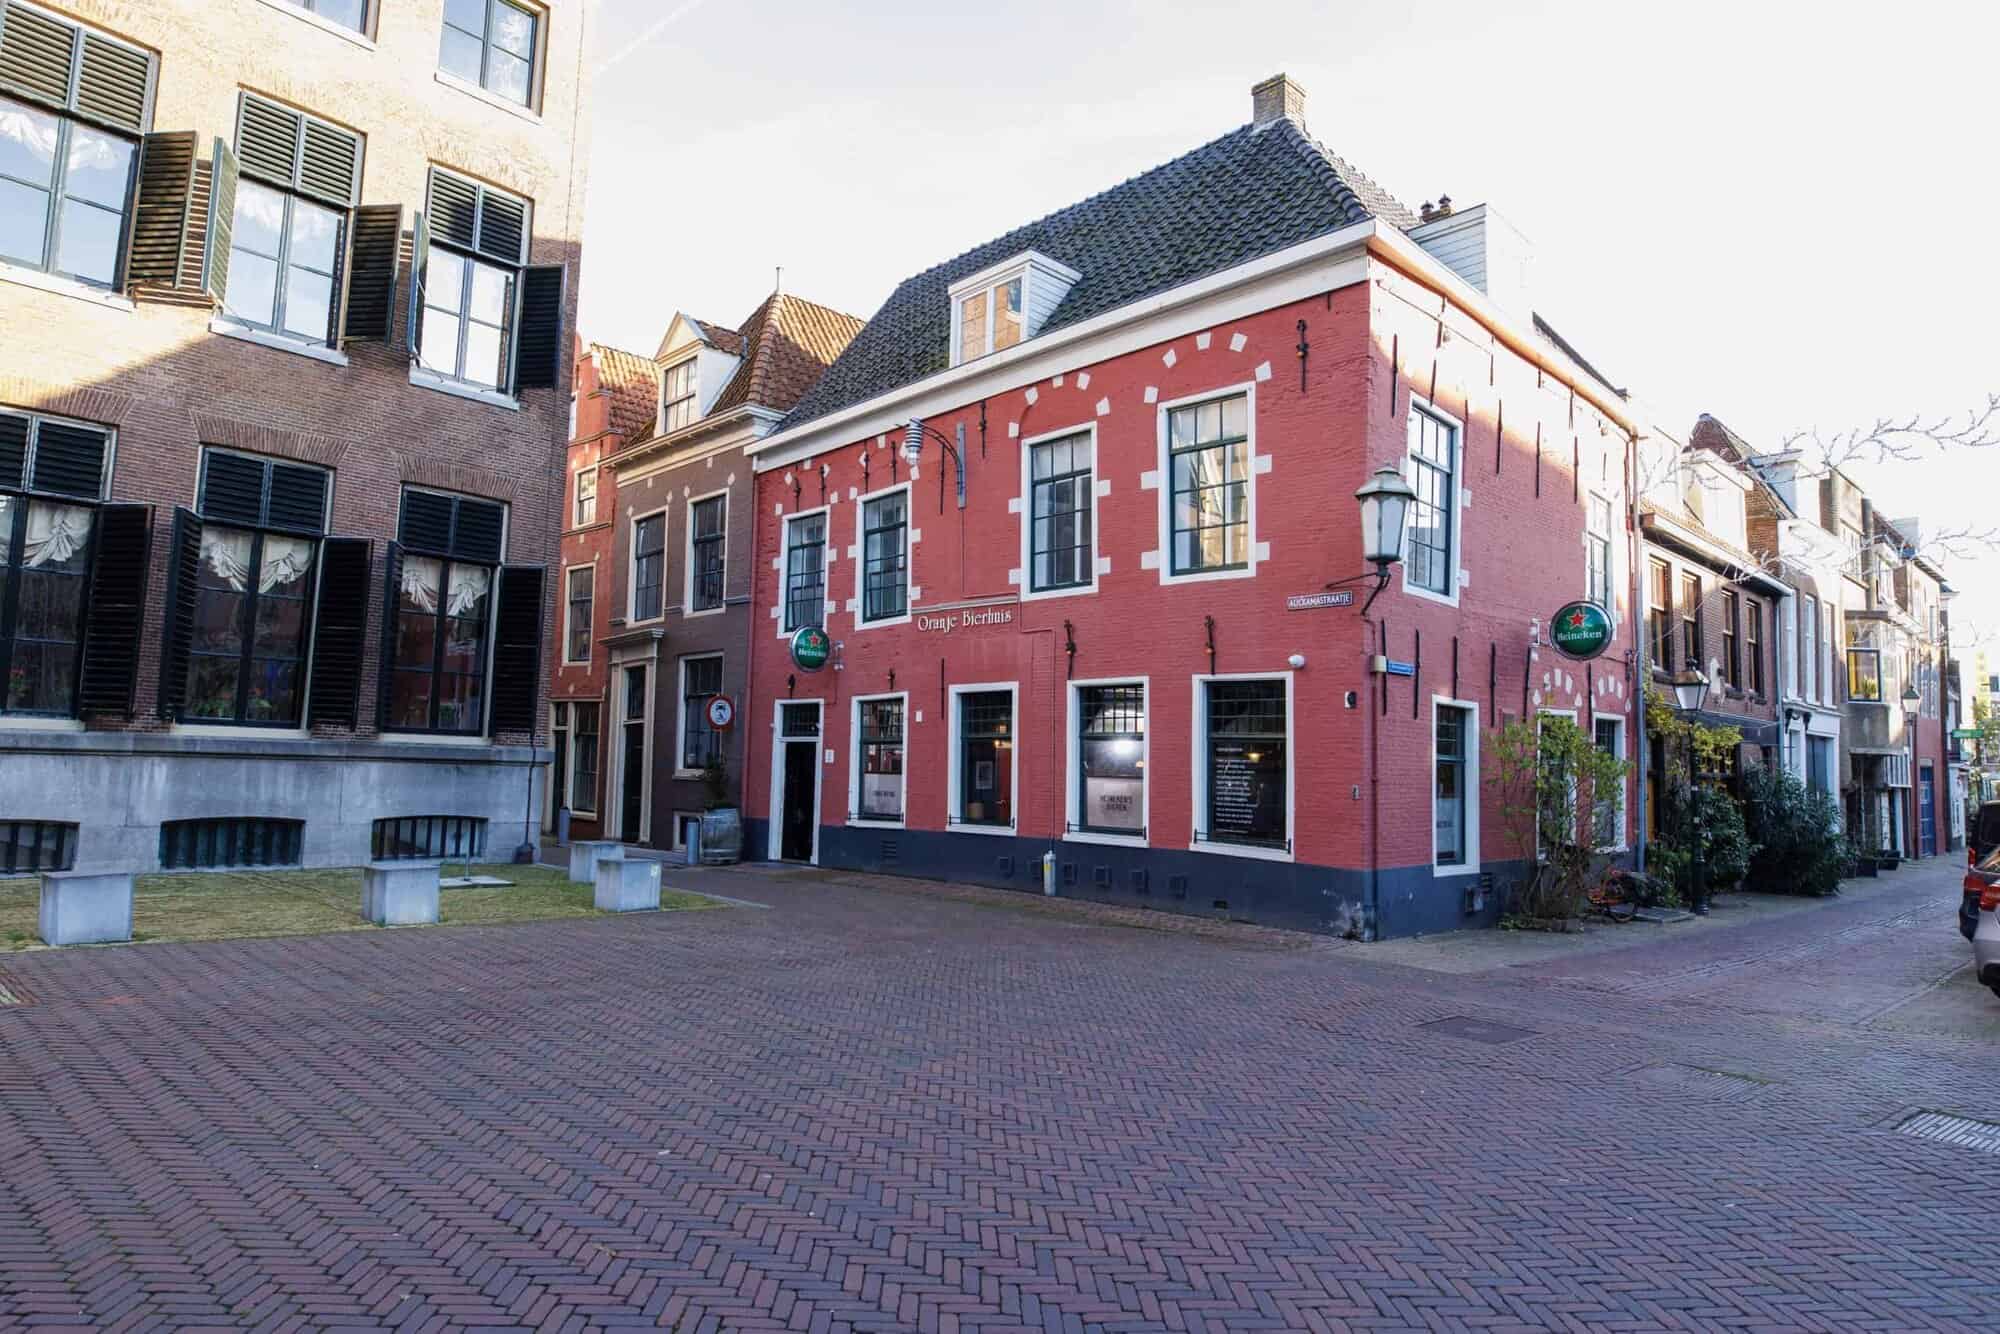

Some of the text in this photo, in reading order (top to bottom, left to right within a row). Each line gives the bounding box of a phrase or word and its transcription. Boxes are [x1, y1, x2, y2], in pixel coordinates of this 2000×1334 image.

[918, 608, 1012, 632] Oranje Bierhuis
[1557, 631, 1602, 640] Heineken
